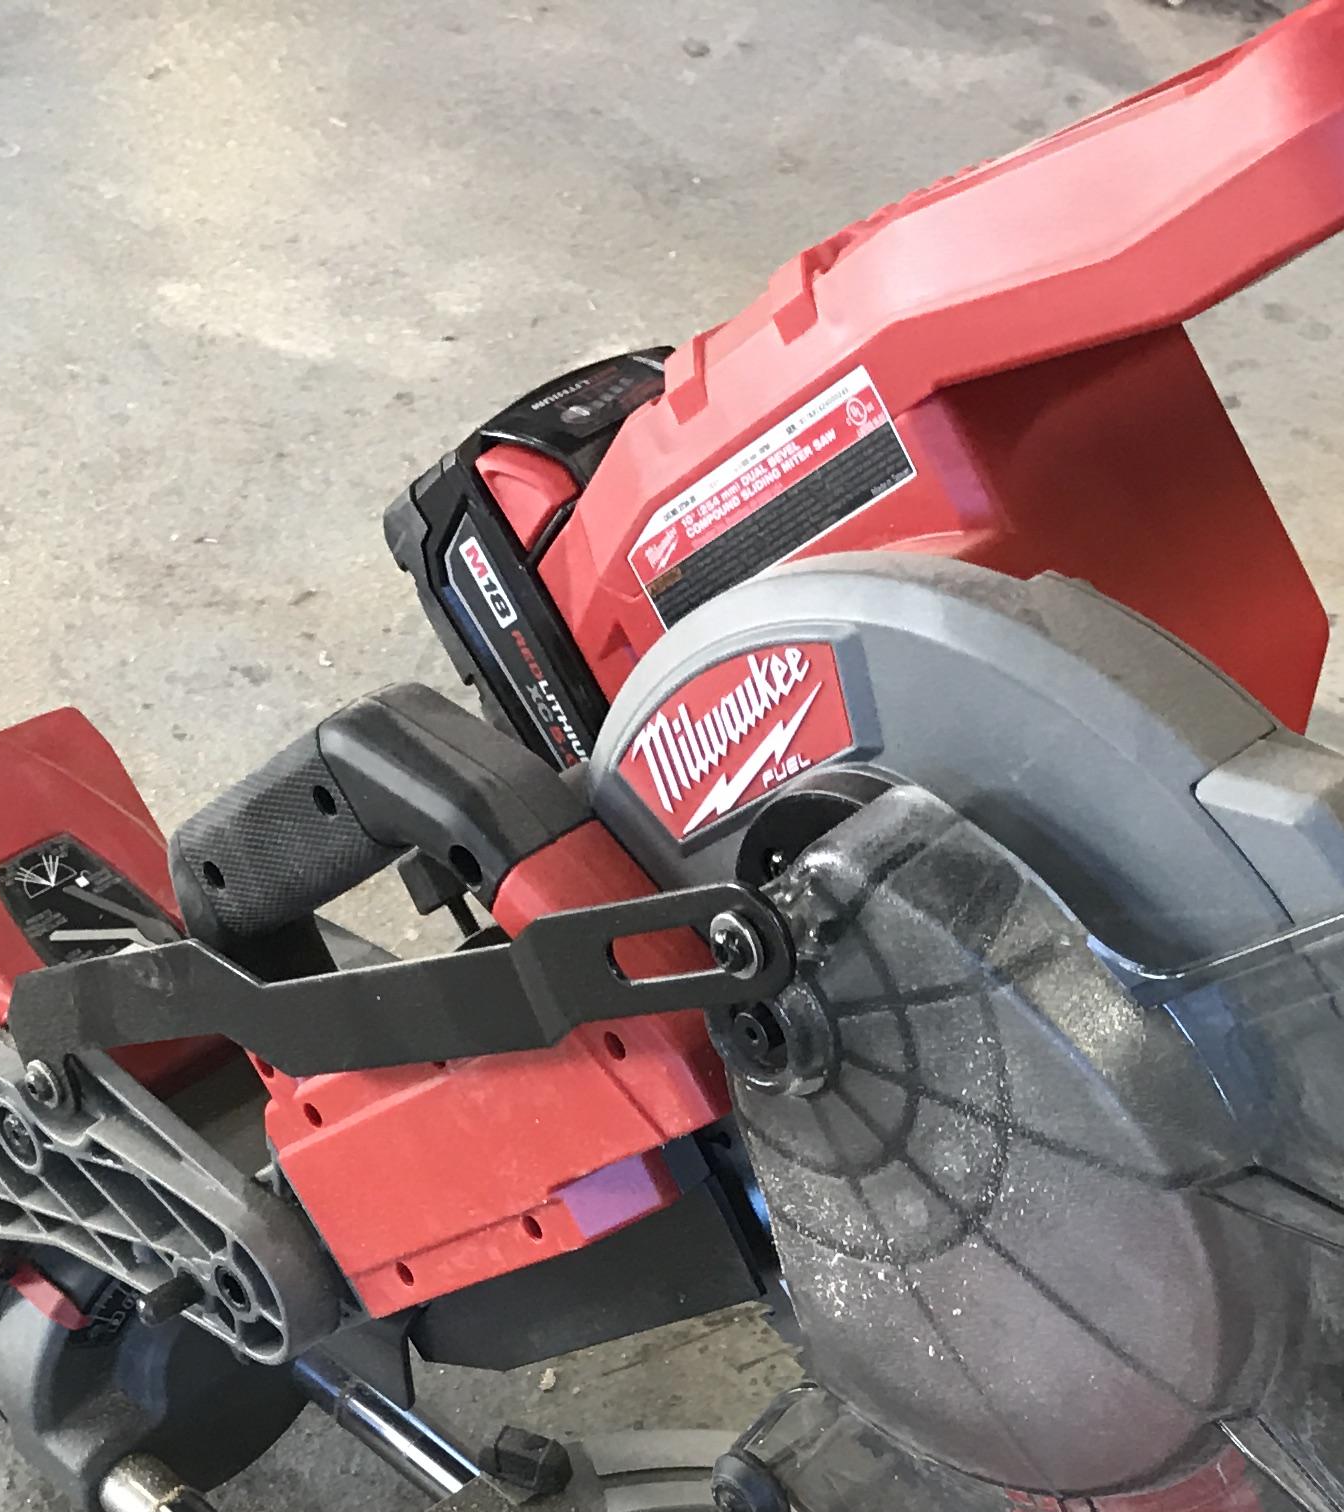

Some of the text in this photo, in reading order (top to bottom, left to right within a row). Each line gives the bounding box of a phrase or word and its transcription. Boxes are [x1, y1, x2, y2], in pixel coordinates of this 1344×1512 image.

[685, 496, 741, 538] COMPOUND
[740, 467, 781, 501] SLIDING
[779, 444, 814, 474] MITER
[812, 427, 837, 452] SAW
[740, 463, 768, 484] DUAL
[767, 441, 801, 467] BEVEL
[465, 545, 512, 620] M18
[631, 647, 810, 814] Milwaukee
[761, 753, 812, 788] FUEL
